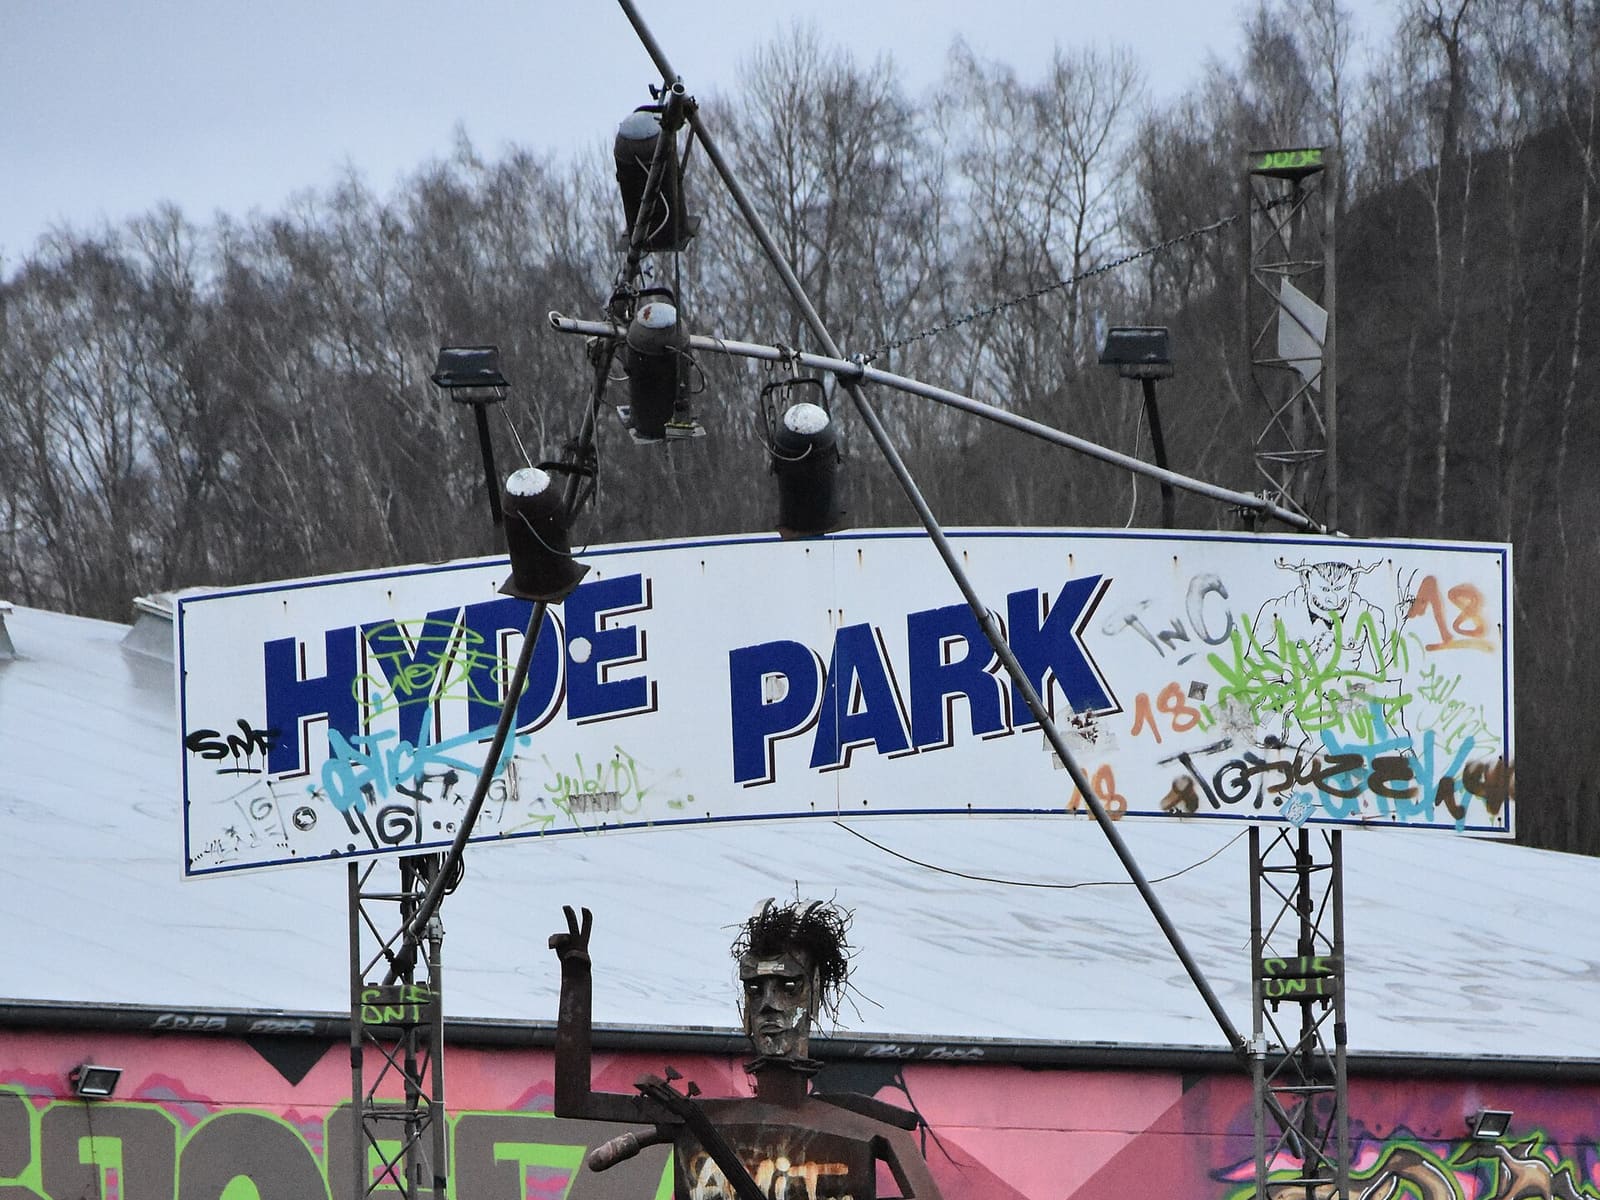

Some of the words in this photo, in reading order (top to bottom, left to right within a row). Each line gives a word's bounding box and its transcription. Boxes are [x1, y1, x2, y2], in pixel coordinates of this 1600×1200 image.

[1407, 574, 1491, 651] 18
[264, 573, 658, 780] HYDE
[729, 574, 1123, 788] PARK
[1130, 681, 1201, 744] 18
